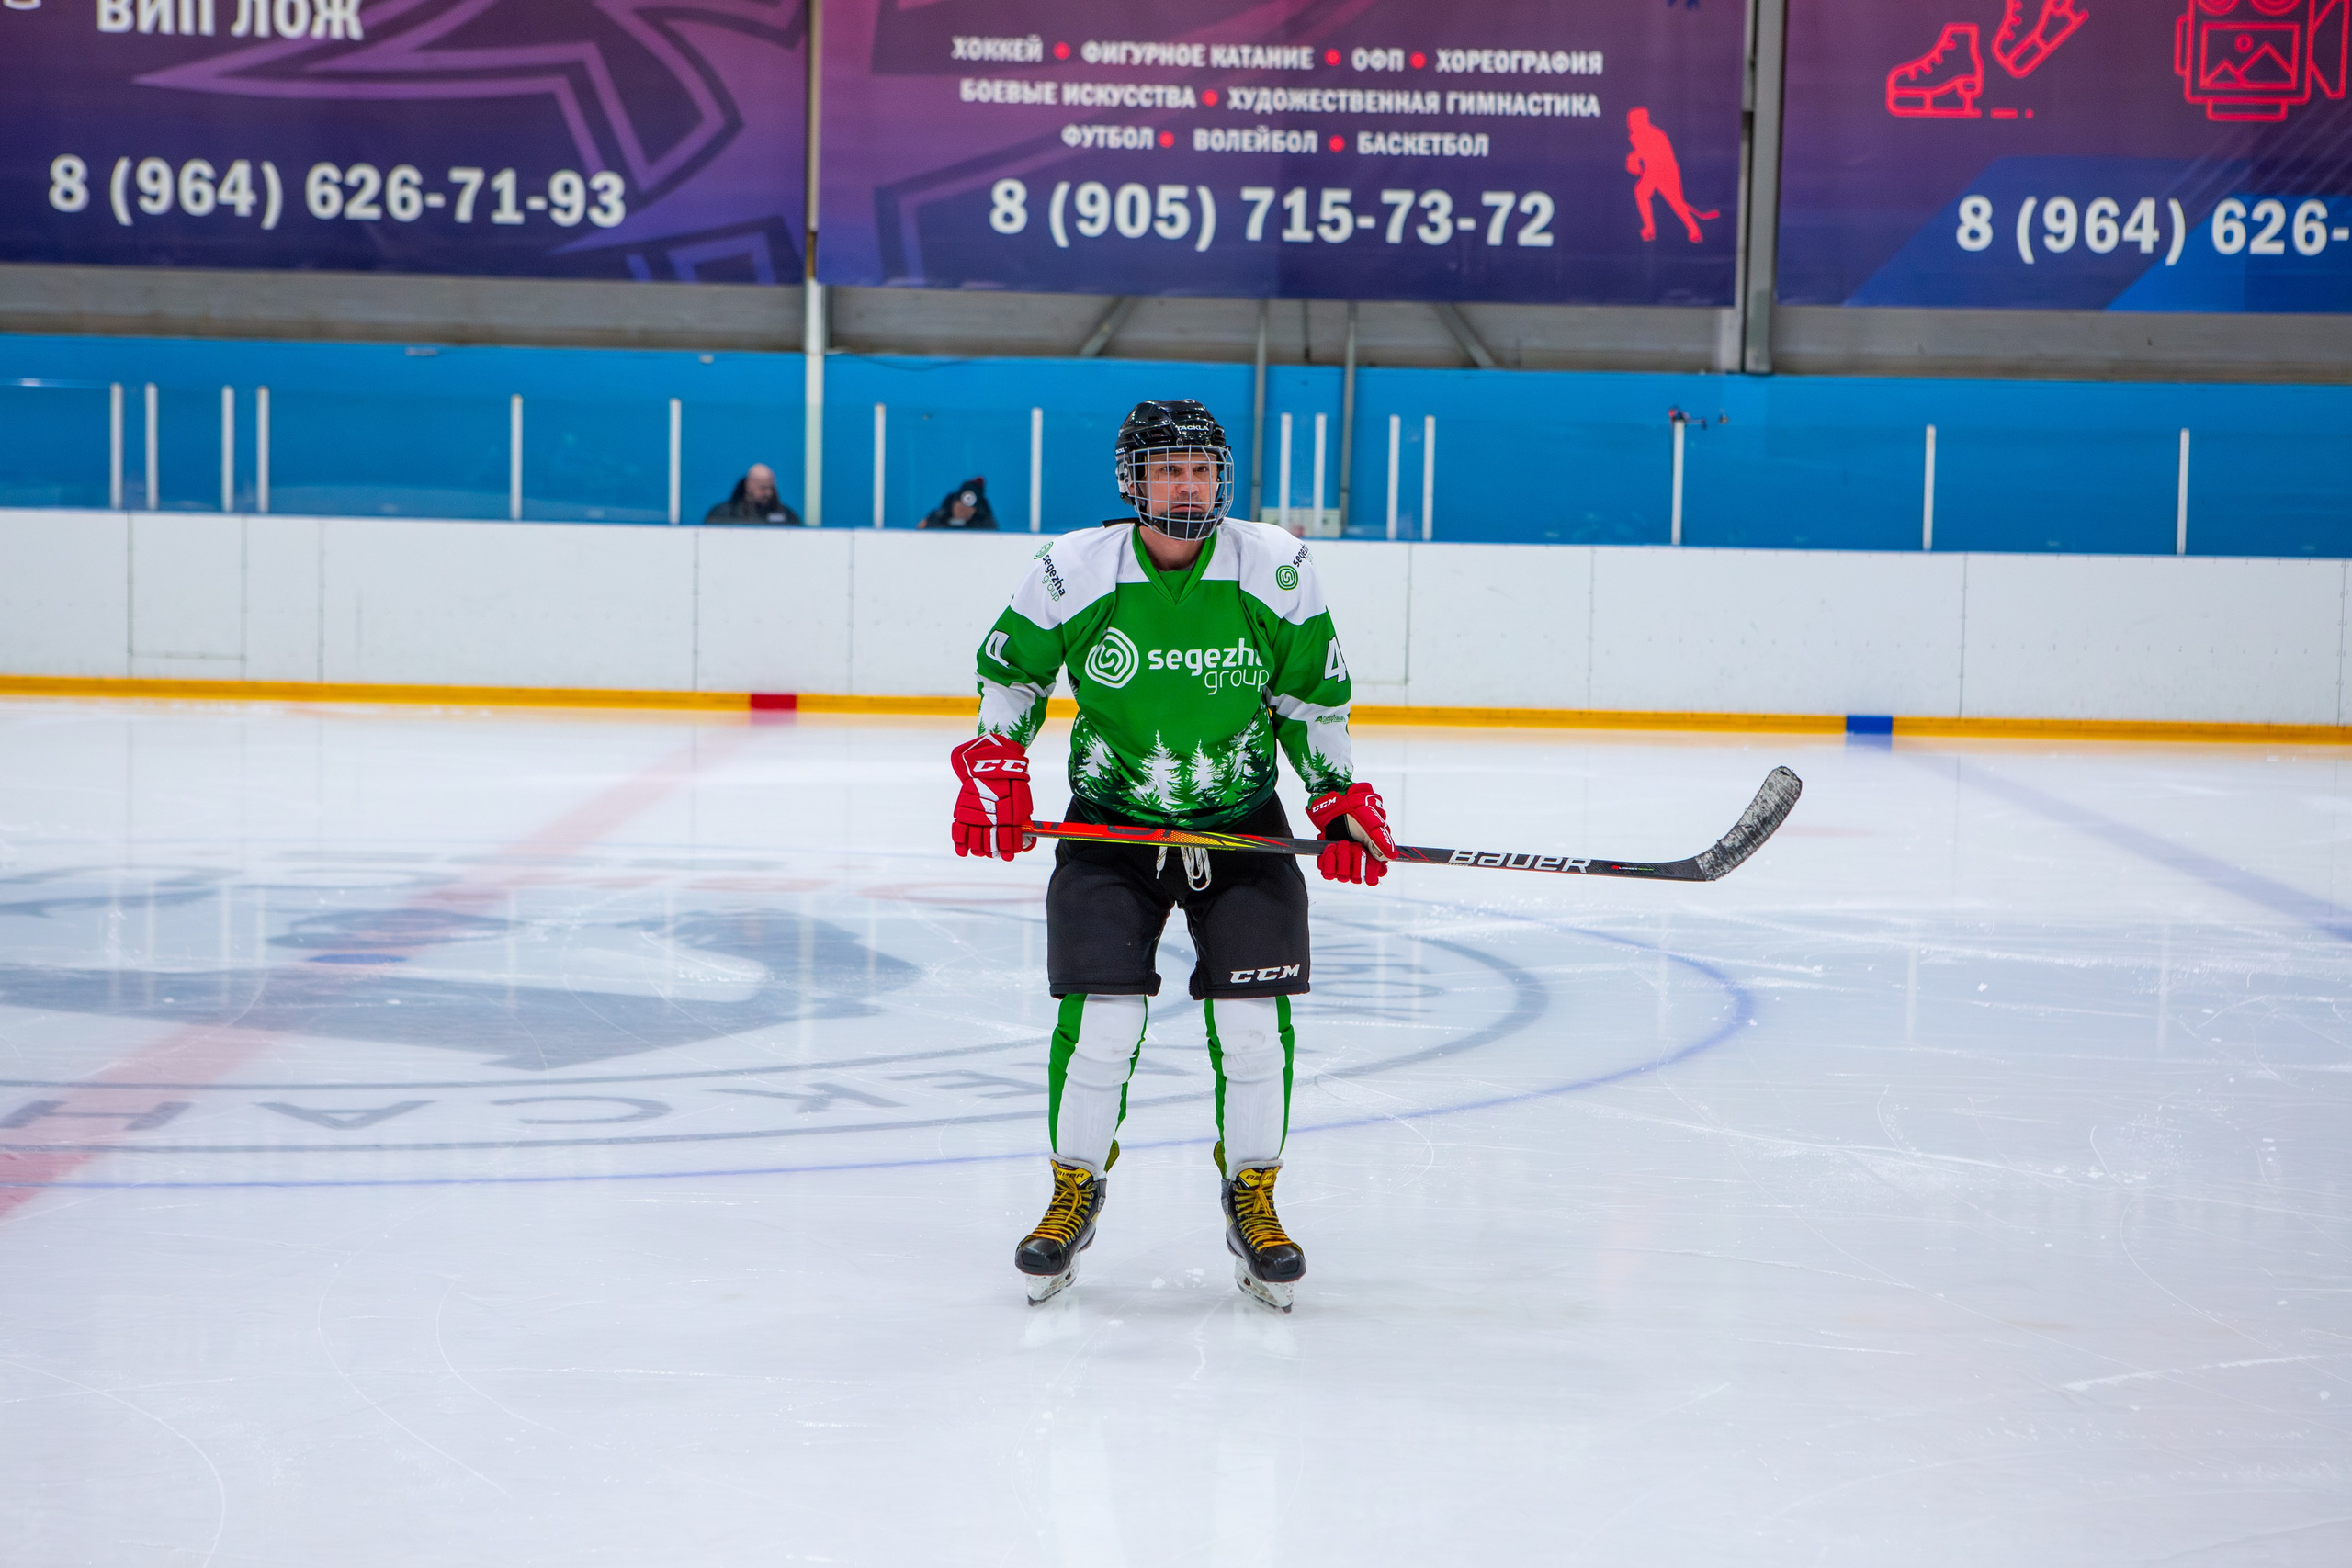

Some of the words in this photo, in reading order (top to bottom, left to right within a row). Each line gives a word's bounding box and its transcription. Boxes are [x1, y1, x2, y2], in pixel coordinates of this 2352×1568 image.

[951, 34, 1044, 62] ХОККЕЙ
[1080, 39, 1207, 68] ФИГУРНОЕ
[1209, 44, 1316, 71] КАТАНИЕ
[1351, 47, 1406, 72] ОФП
[1435, 49, 1604, 76] ХОРЕОГРАФИЯ
[959, 77, 1059, 106] БОЕВЫЕ
[1061, 82, 1198, 109] ИСКУССТВА
[1227, 86, 1441, 116] ХУДОЖЕСТВЕННАЯ
[1445, 90, 1602, 118] ГИМНАСТИКА
[1060, 123, 1155, 151] ФУТБОЛ
[1192, 125, 1319, 154] ВОЛЕЙБОЛ
[1356, 130, 1490, 158] БАСКЕТБОЛ
[48, 154, 89, 213] 8
[109, 156, 283, 231] (964)
[305, 163, 628, 229] 626-71-93
[989, 178, 1028, 235] 8
[1048, 181, 1217, 253] (905)
[1239, 186, 1555, 248] 715-73-72
[1955, 194, 1995, 253] 8
[2015, 196, 2188, 267] (964)
[2211, 197, 2352, 257] 626-
[1041, 575, 1060, 603] group
[1042, 554, 1066, 597] segezha
[1323, 634, 1347, 683] 4
[1204, 669, 1270, 695] group
[972, 759, 1027, 773] CC
[1312, 795, 1338, 813] CCM
[1229, 964, 1301, 984] CCM
[1054, 1168, 1085, 1179] AUER
